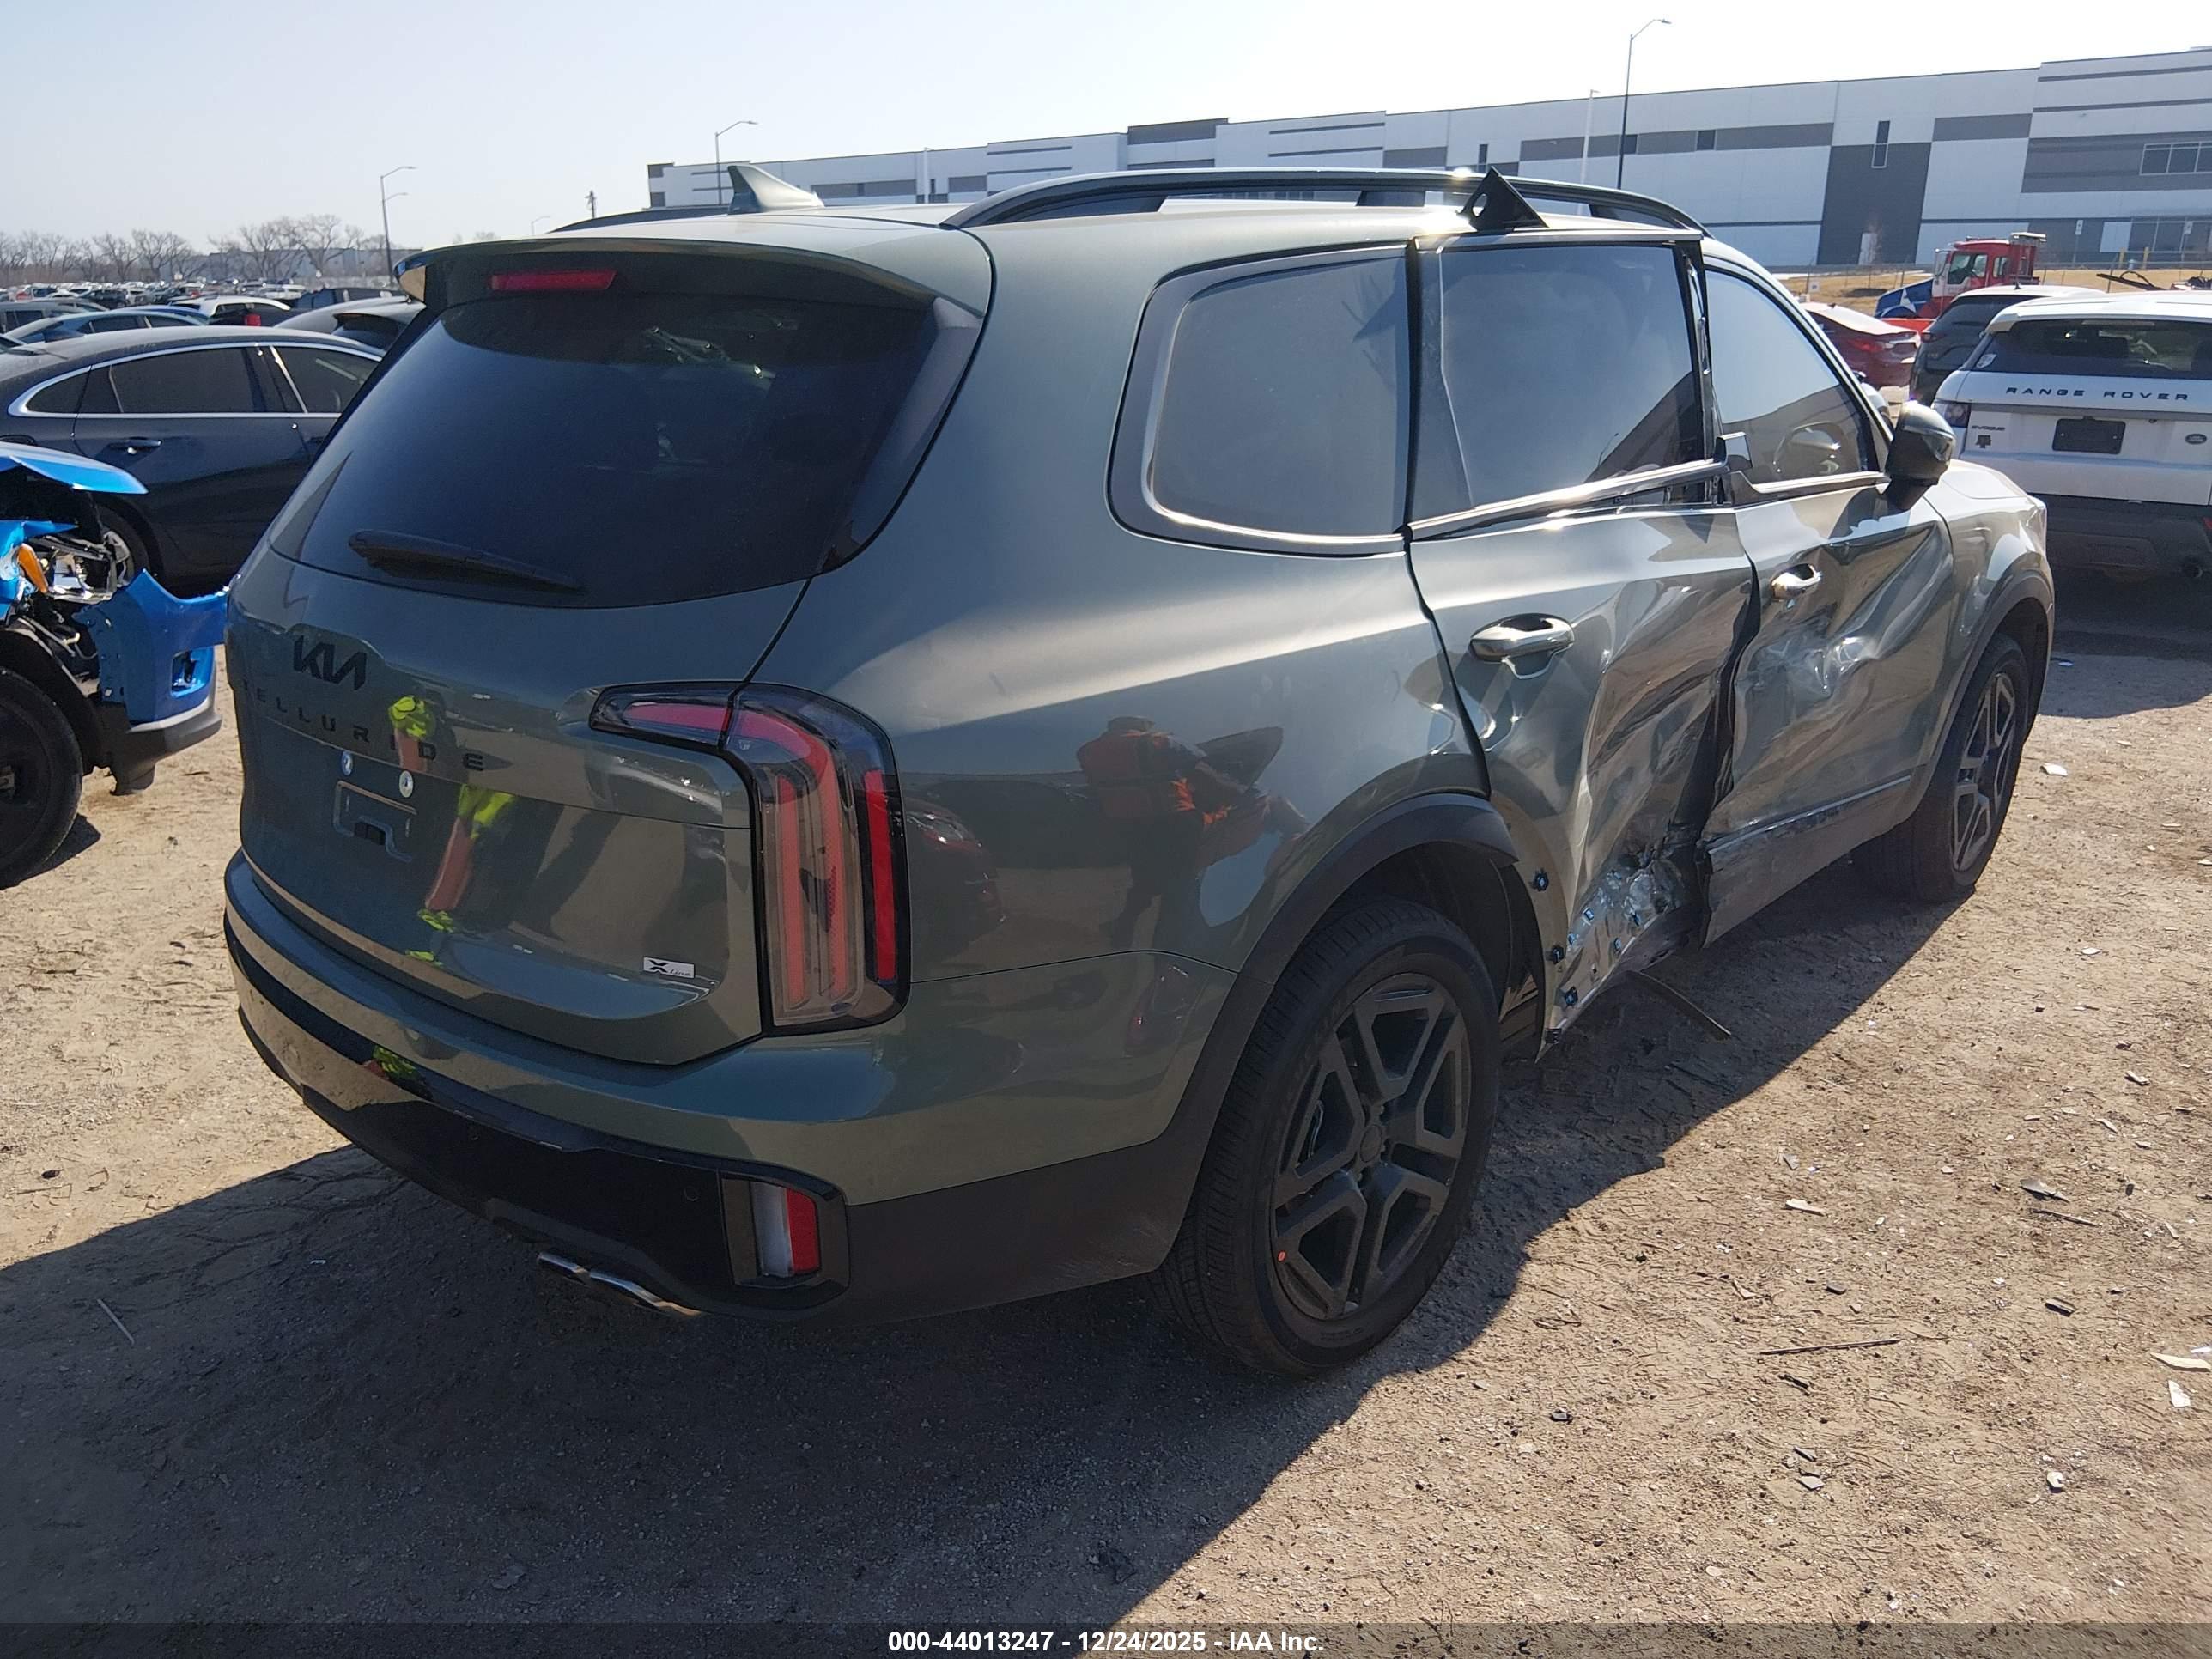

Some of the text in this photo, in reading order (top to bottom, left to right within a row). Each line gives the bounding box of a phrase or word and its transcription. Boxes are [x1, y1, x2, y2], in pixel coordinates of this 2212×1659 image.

[2005, 387, 2188, 401] RANGE ROVER
[293, 635, 368, 690] KIA
